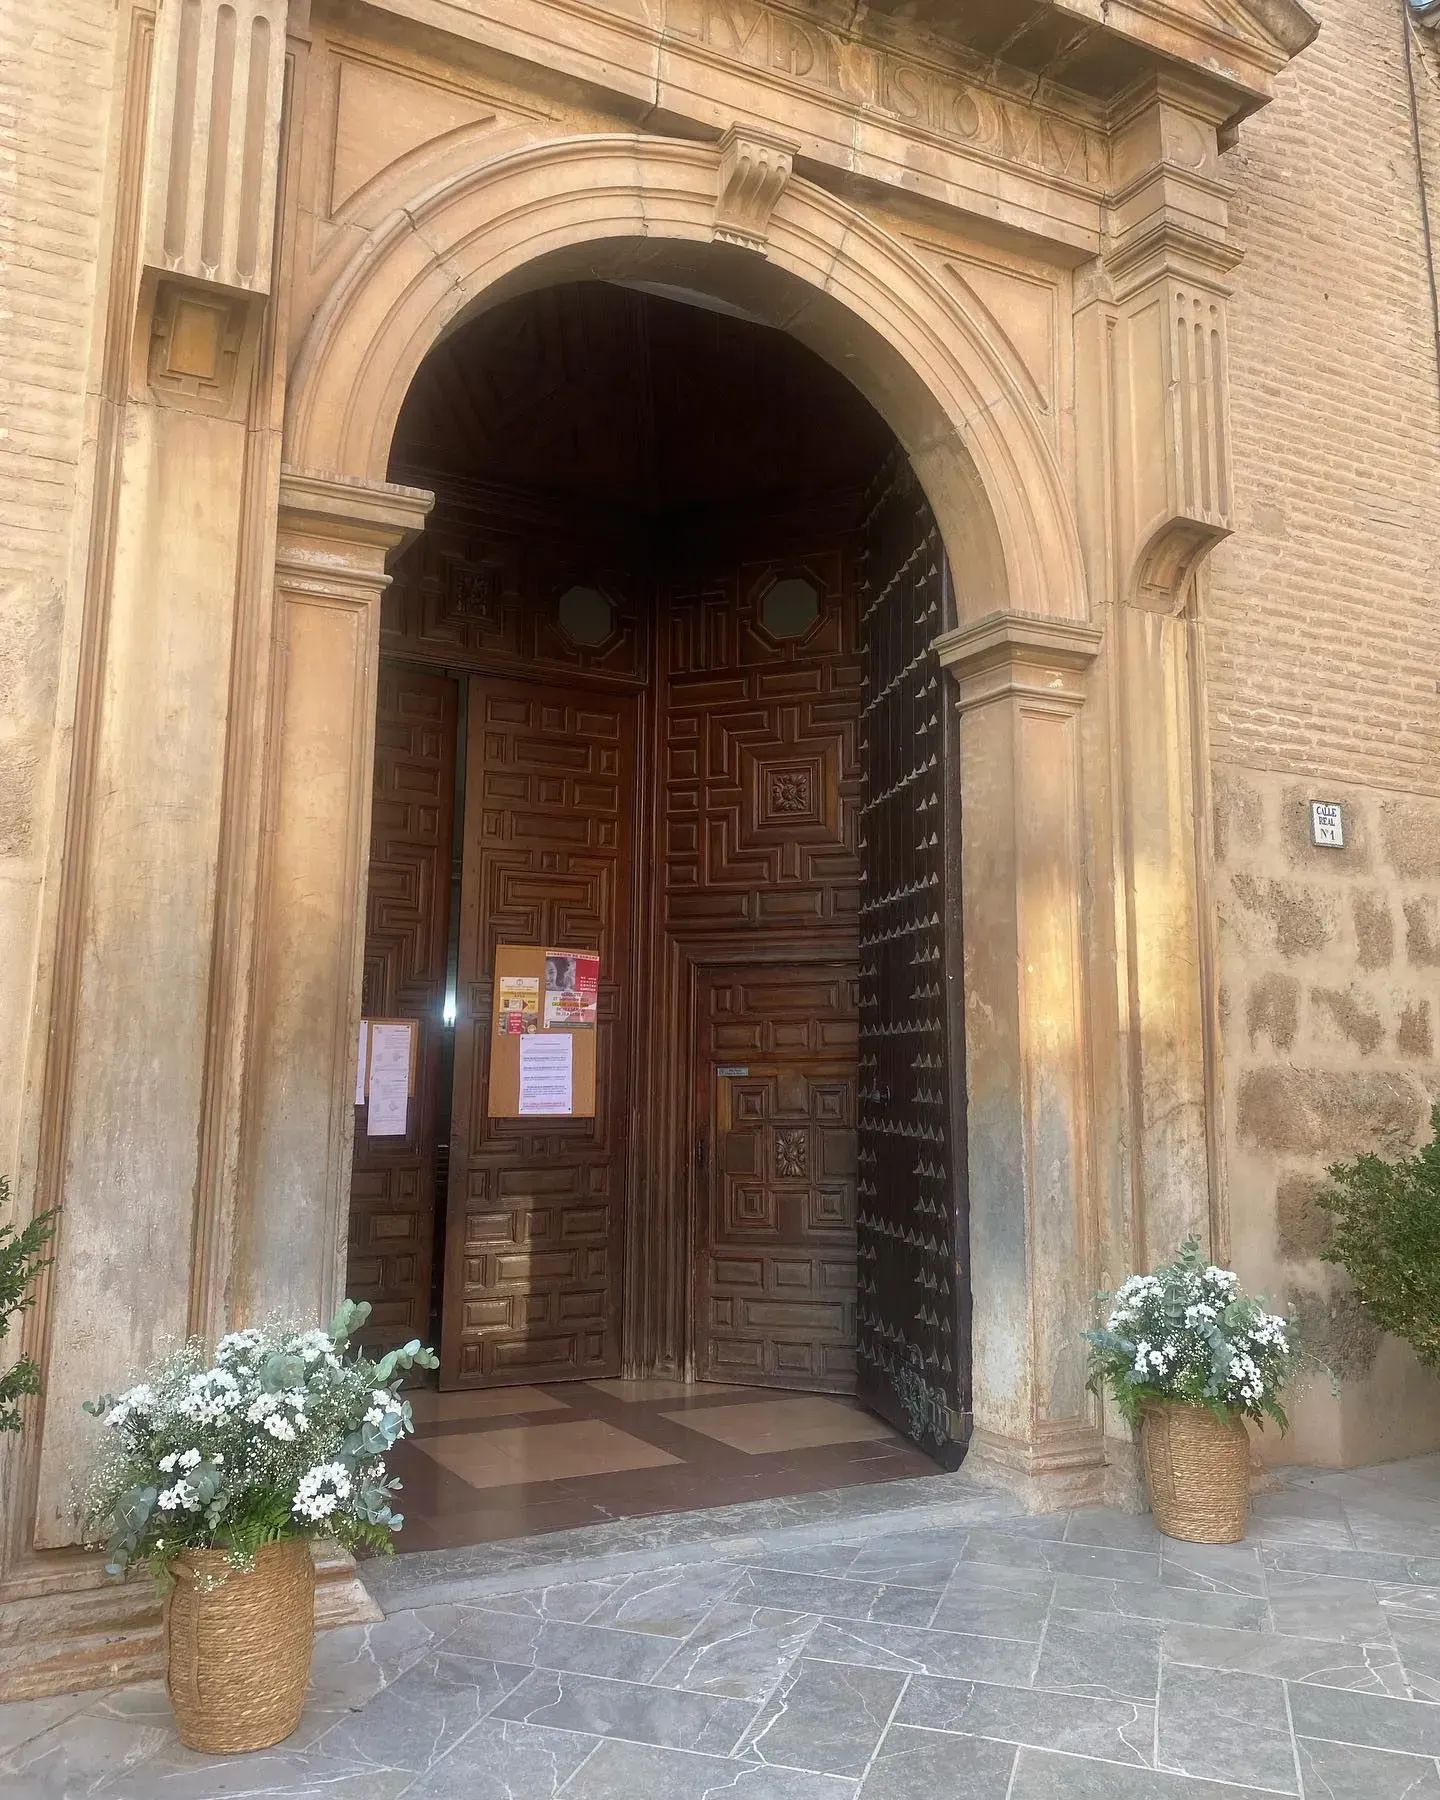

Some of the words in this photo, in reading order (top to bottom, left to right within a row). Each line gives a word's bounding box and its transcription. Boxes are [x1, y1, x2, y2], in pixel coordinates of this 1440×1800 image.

[1316, 806, 1337, 817] CALLE
[1319, 816, 1336, 827] REAL
[1330, 830, 1335, 840] 1
